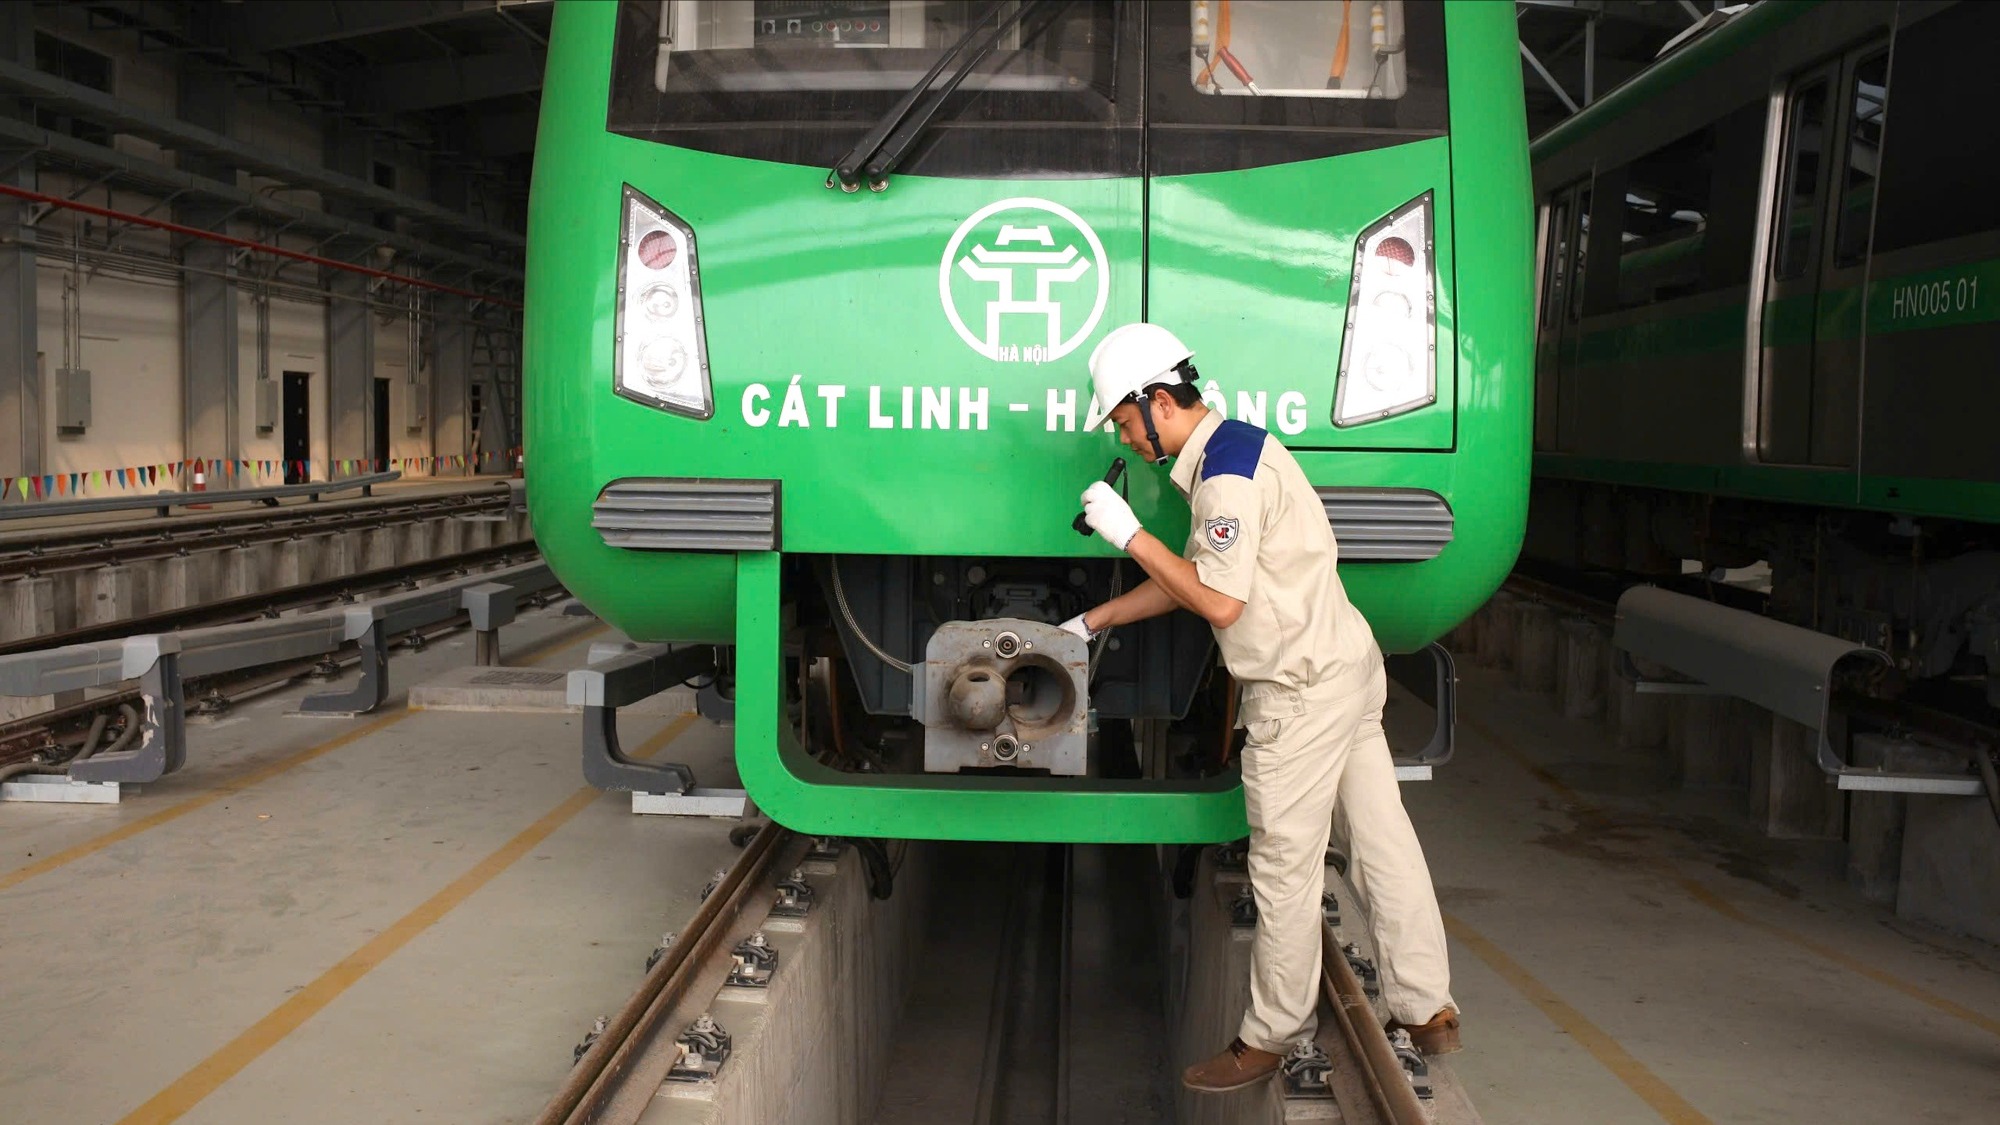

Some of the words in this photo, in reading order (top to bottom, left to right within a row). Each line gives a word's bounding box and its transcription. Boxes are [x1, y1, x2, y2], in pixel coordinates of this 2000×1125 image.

[1892, 280, 1951, 319] HN005
[1956, 276, 1977, 311] 01
[999, 343, 1020, 362] HÀ
[1023, 343, 1048, 366] NỘI
[741, 374, 846, 428] CÁT
[869, 385, 989, 430] LINH
[1200, 379, 1308, 436] ÔNG
